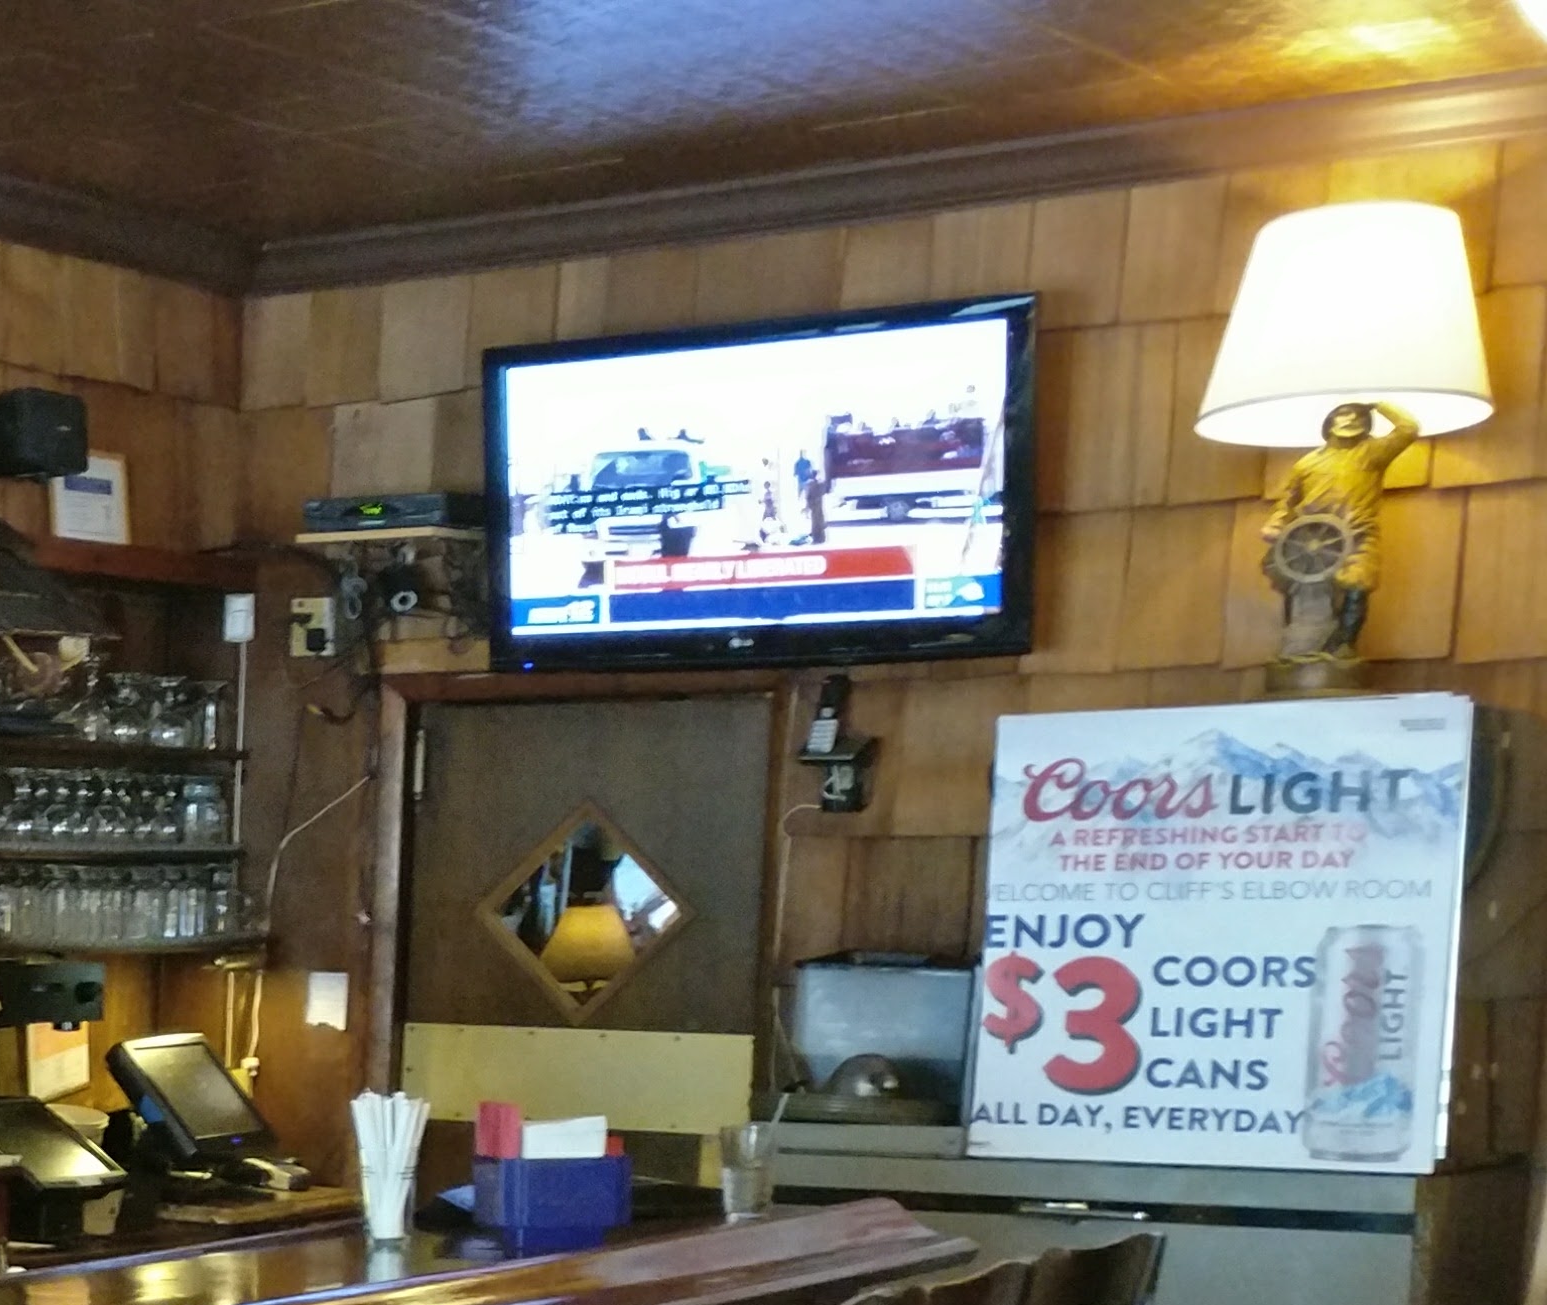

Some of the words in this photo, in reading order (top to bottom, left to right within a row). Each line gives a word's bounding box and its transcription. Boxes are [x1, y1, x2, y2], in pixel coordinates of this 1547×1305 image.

[1023, 757, 1218, 822] Coors
[1228, 769, 1416, 815] LIGHT
[1050, 829, 1066, 846] A
[1073, 825, 1238, 846] REFRESHING
[1245, 823, 1324, 844] START
[1331, 822, 1367, 844] TO
[1060, 853, 1106, 871] THE
[1114, 852, 1166, 871] END
[1175, 852, 1211, 870] OF
[1219, 851, 1292, 870] YOUR
[1307, 849, 1356, 868] DAY
[1105, 882, 1139, 901] TO
[1147, 881, 1235, 901] CLIFF'S
[1242, 880, 1337, 900] ELBOW
[1345, 878, 1432, 900] ROOM
[986, 913, 1145, 949] ENJOY
[1153, 955, 1317, 988] COORS
[983, 951, 1143, 1096] $3
[1150, 1008, 1283, 1039] LIGHT
[1378, 969, 1408, 1060] LIGHT
[1146, 1057, 1269, 1091] CANS
[971, 1103, 1028, 1126] ALL
[1038, 1104, 1113, 1133] DAY,
[1123, 1105, 1306, 1134] EVERYDAY
